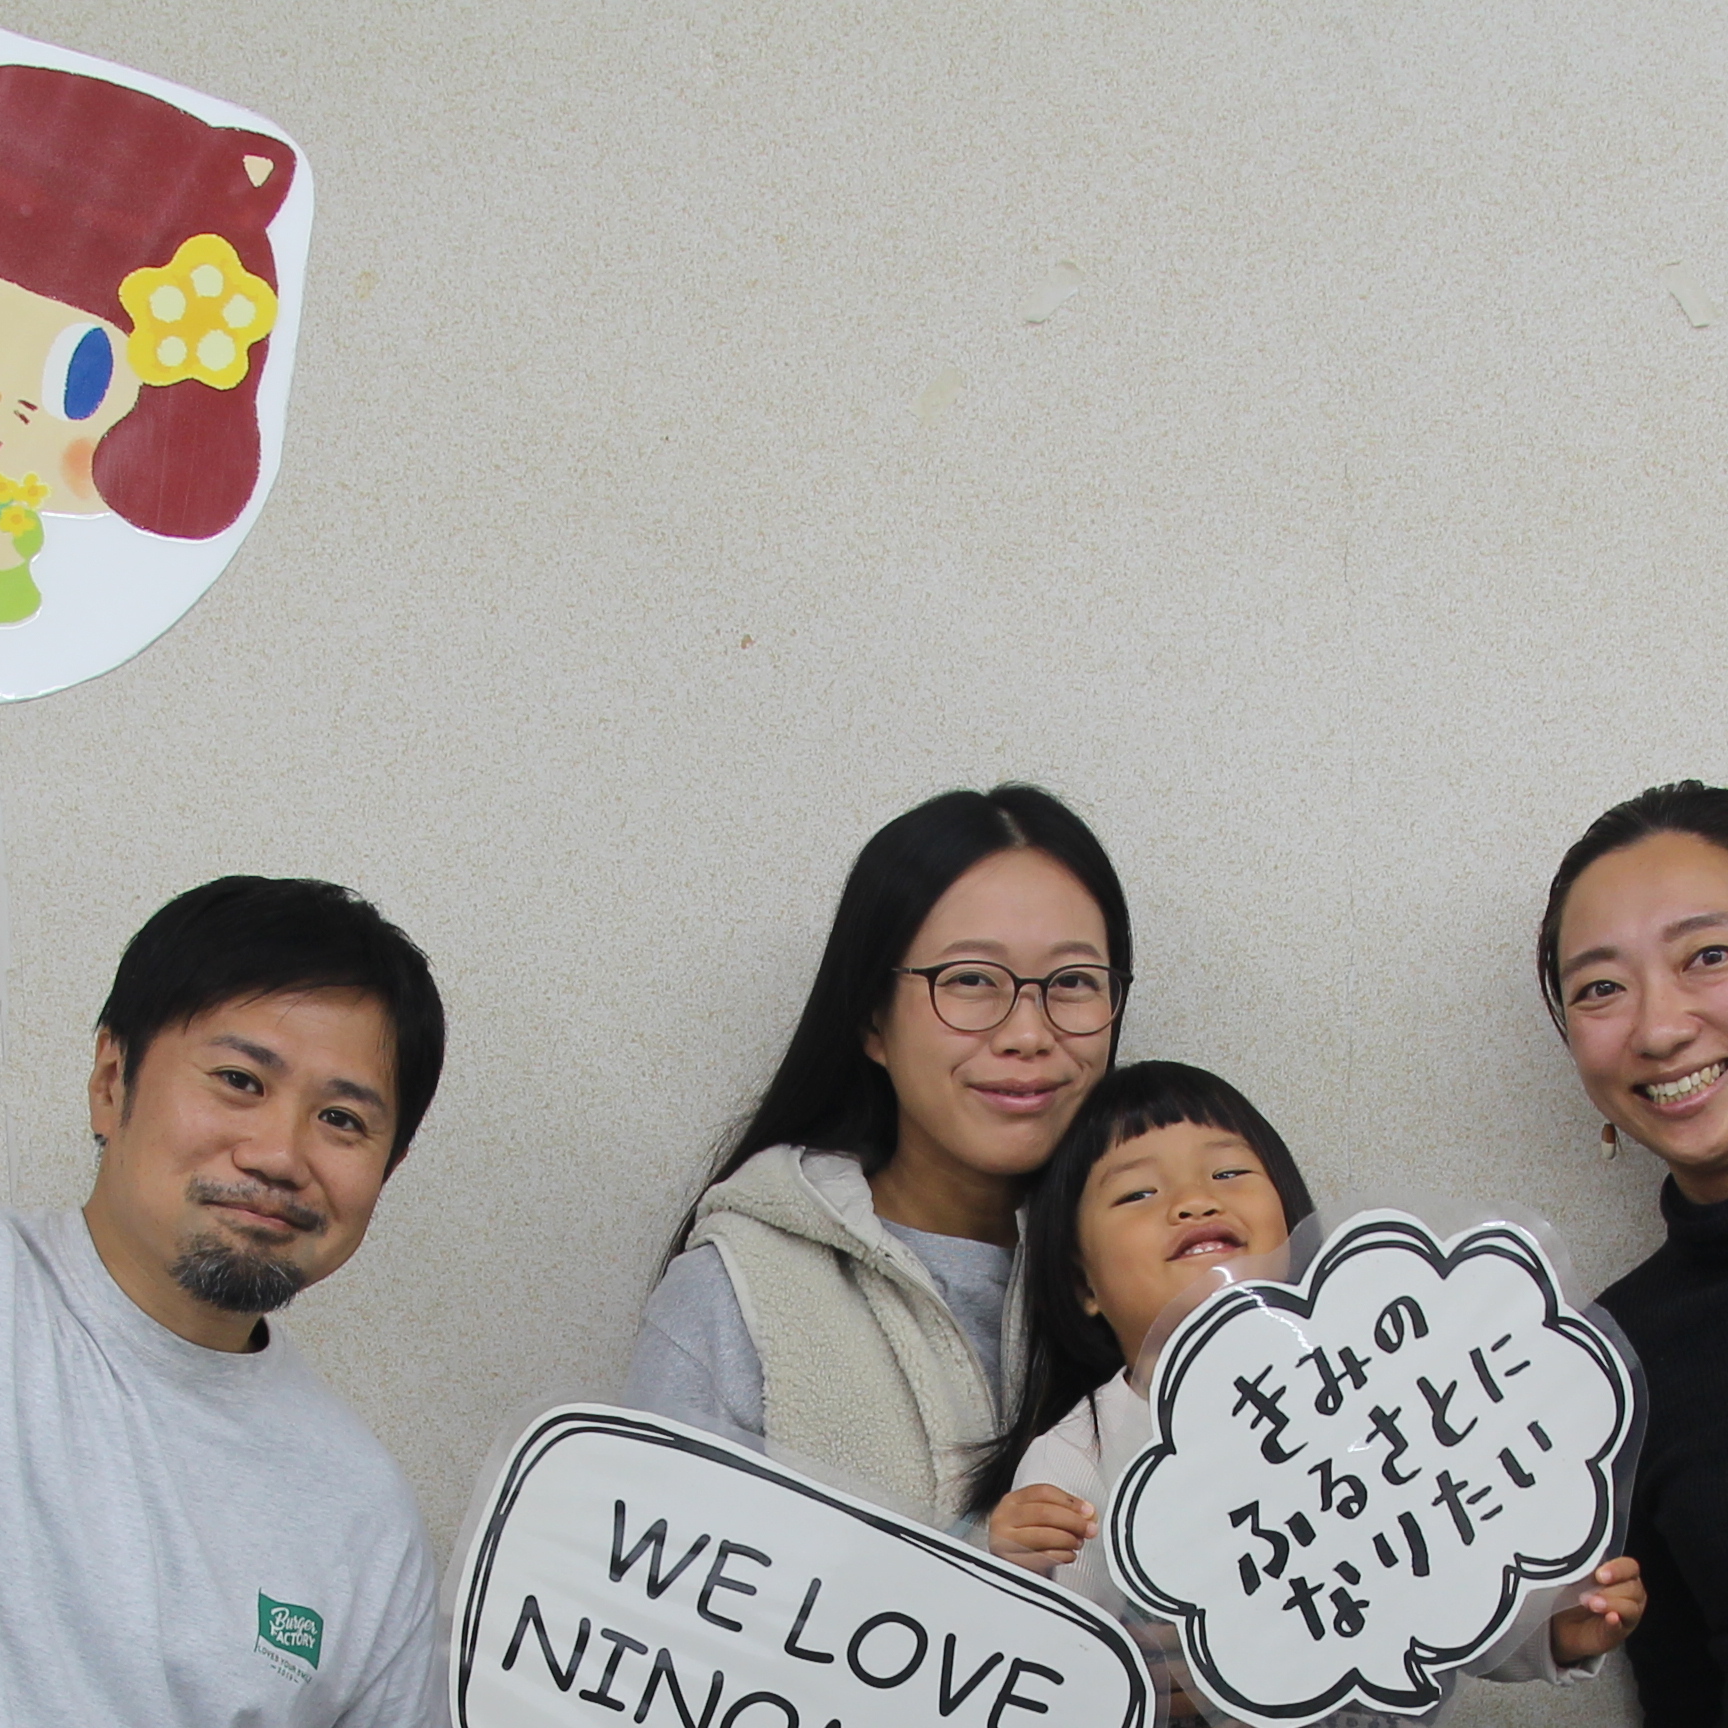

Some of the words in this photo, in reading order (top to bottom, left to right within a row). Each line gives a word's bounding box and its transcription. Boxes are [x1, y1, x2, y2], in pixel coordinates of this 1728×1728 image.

[1232, 1295, 1429, 1464] きみの
[1228, 1333, 1531, 1596] ふるさとに
[1282, 1420, 1553, 1641] なりたい
[270, 1606, 318, 1635] Burger
[608, 1499, 772, 1633] WE
